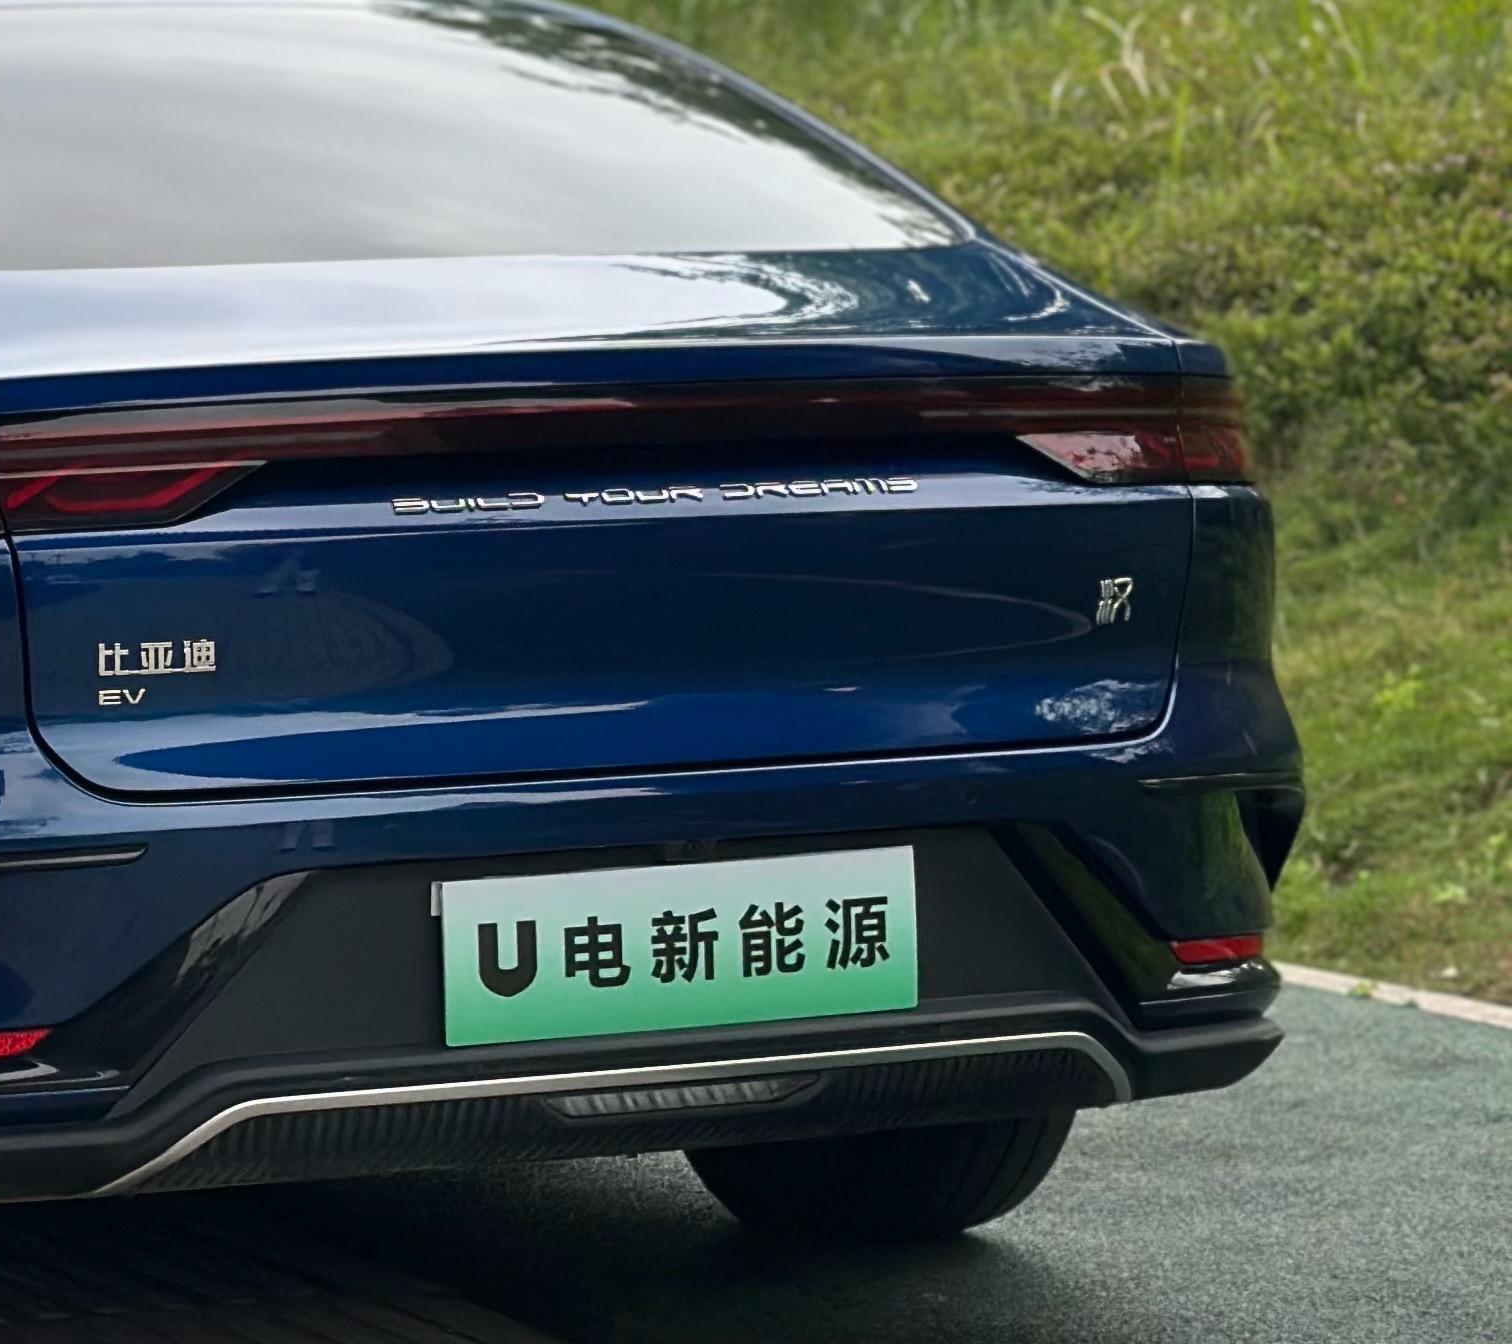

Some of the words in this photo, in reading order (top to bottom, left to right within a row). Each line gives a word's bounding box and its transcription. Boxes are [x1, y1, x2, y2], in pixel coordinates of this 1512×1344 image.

[391, 491, 544, 514] BUILD
[564, 487, 704, 506] YOUR
[719, 476, 919, 500] DREAMS
[98, 639, 216, 676] 比亚迪
[98, 688, 146, 705] EV
